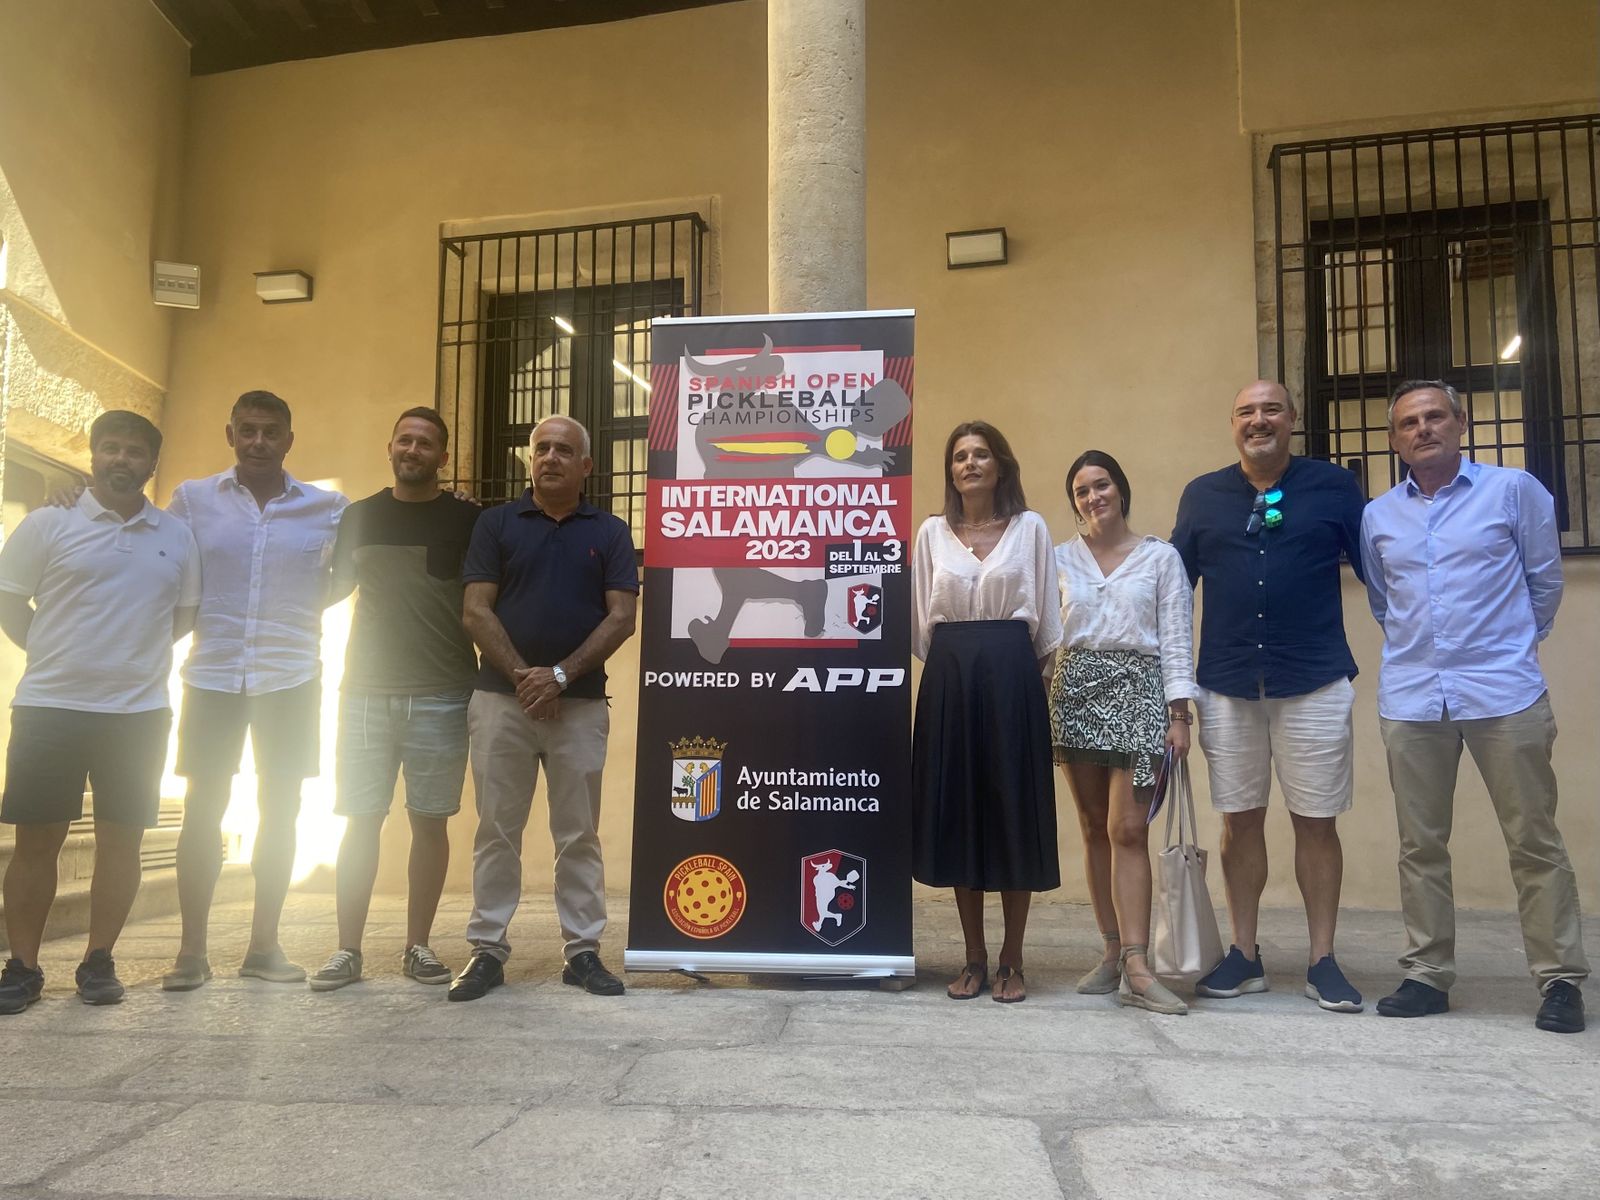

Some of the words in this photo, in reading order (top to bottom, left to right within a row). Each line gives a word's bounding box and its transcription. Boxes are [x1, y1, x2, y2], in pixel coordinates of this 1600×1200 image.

[688, 374, 796, 392] SPANISH
[807, 372, 875, 389] OPEN
[687, 389, 875, 411] PICKLEBALL
[687, 408, 874, 426] CHAMPIONSHIPS
[661, 484, 898, 508] INTERNATIONAL
[660, 509, 897, 538] SALAMANCA
[745, 539, 811, 560] 2023
[829, 551, 853, 562] DEL
[852, 539, 862, 561] 1
[864, 551, 881, 562] AL
[882, 538, 902, 562] 3
[829, 563, 902, 574] SEPTIEMBRE
[644, 671, 740, 688] POWERED
[751, 672, 777, 688] BY
[782, 667, 905, 693] APP
[736, 765, 881, 789] Ayuntamiento
[736, 790, 761, 810] de
[768, 790, 880, 812] Salamanca
[674, 858, 716, 881] PICKLEBALL
[717, 862, 738, 882] SPAIN
